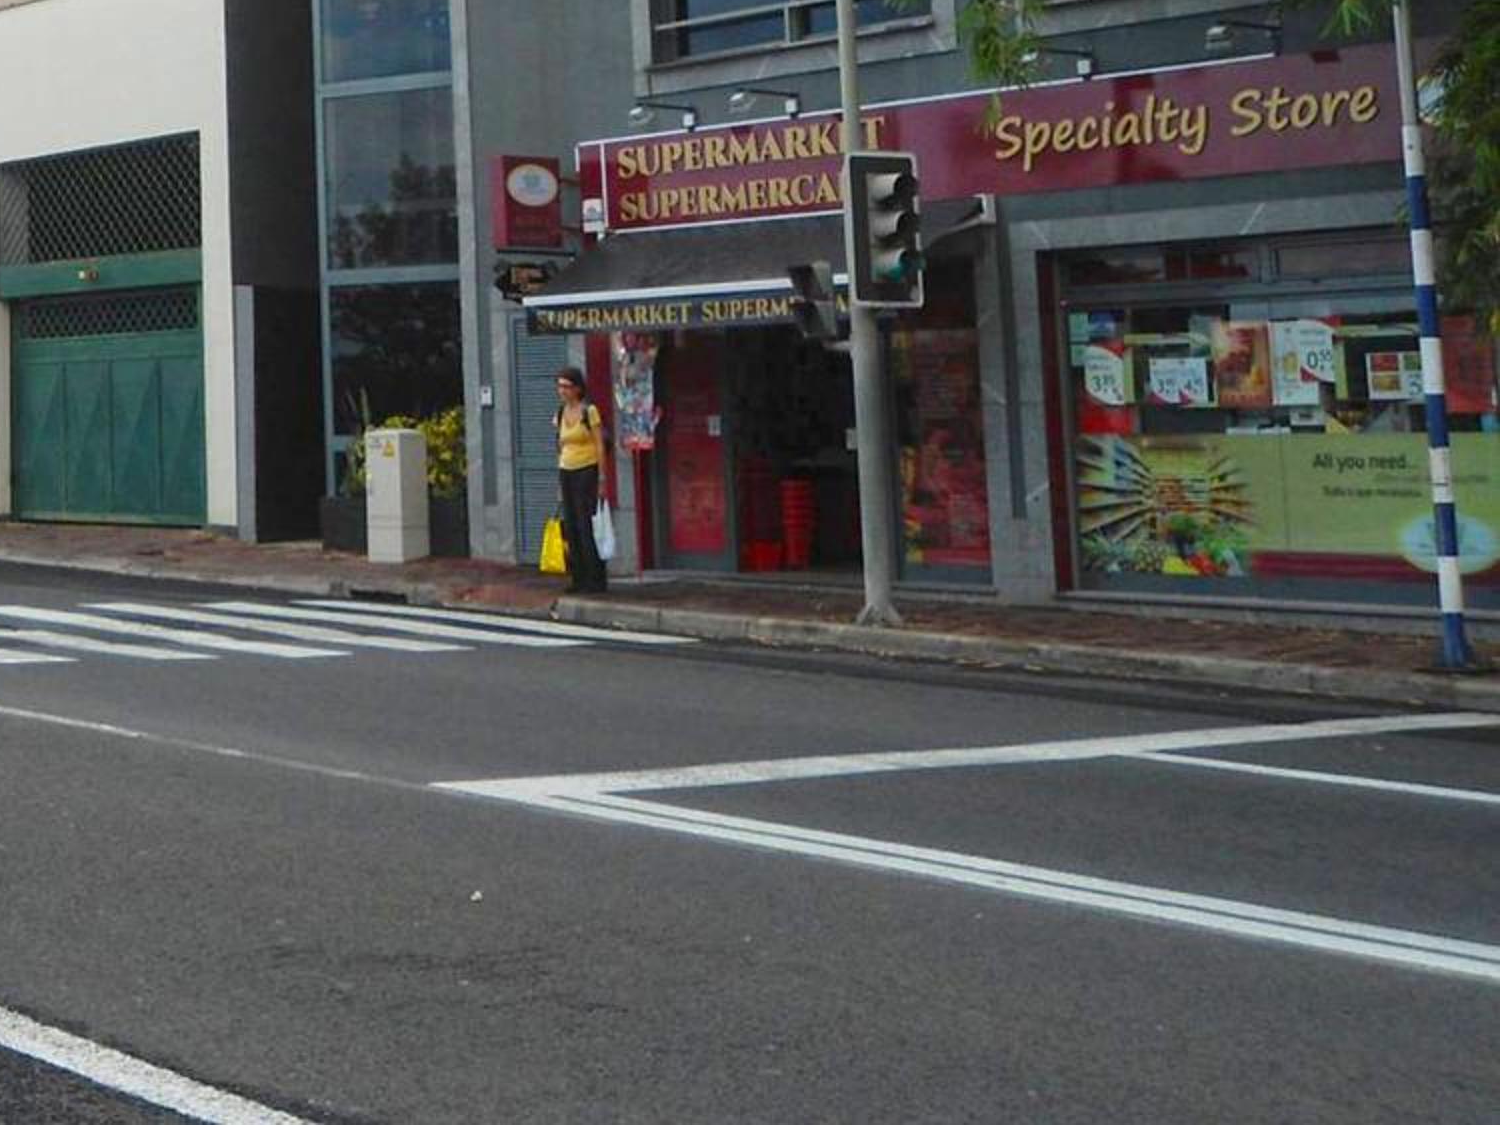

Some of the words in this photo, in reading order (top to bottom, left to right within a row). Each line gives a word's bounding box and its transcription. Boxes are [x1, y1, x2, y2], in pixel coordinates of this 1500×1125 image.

[617, 116, 885, 179] SUPERMARKT
[996, 94, 1209, 172] Specialty
[1231, 86, 1378, 137] Store
[619, 173, 845, 222] SUPERMERCA
[537, 302, 693, 329] SUPERMARKET
[1312, 453, 1333, 469] All
[1336, 456, 1365, 474] you
